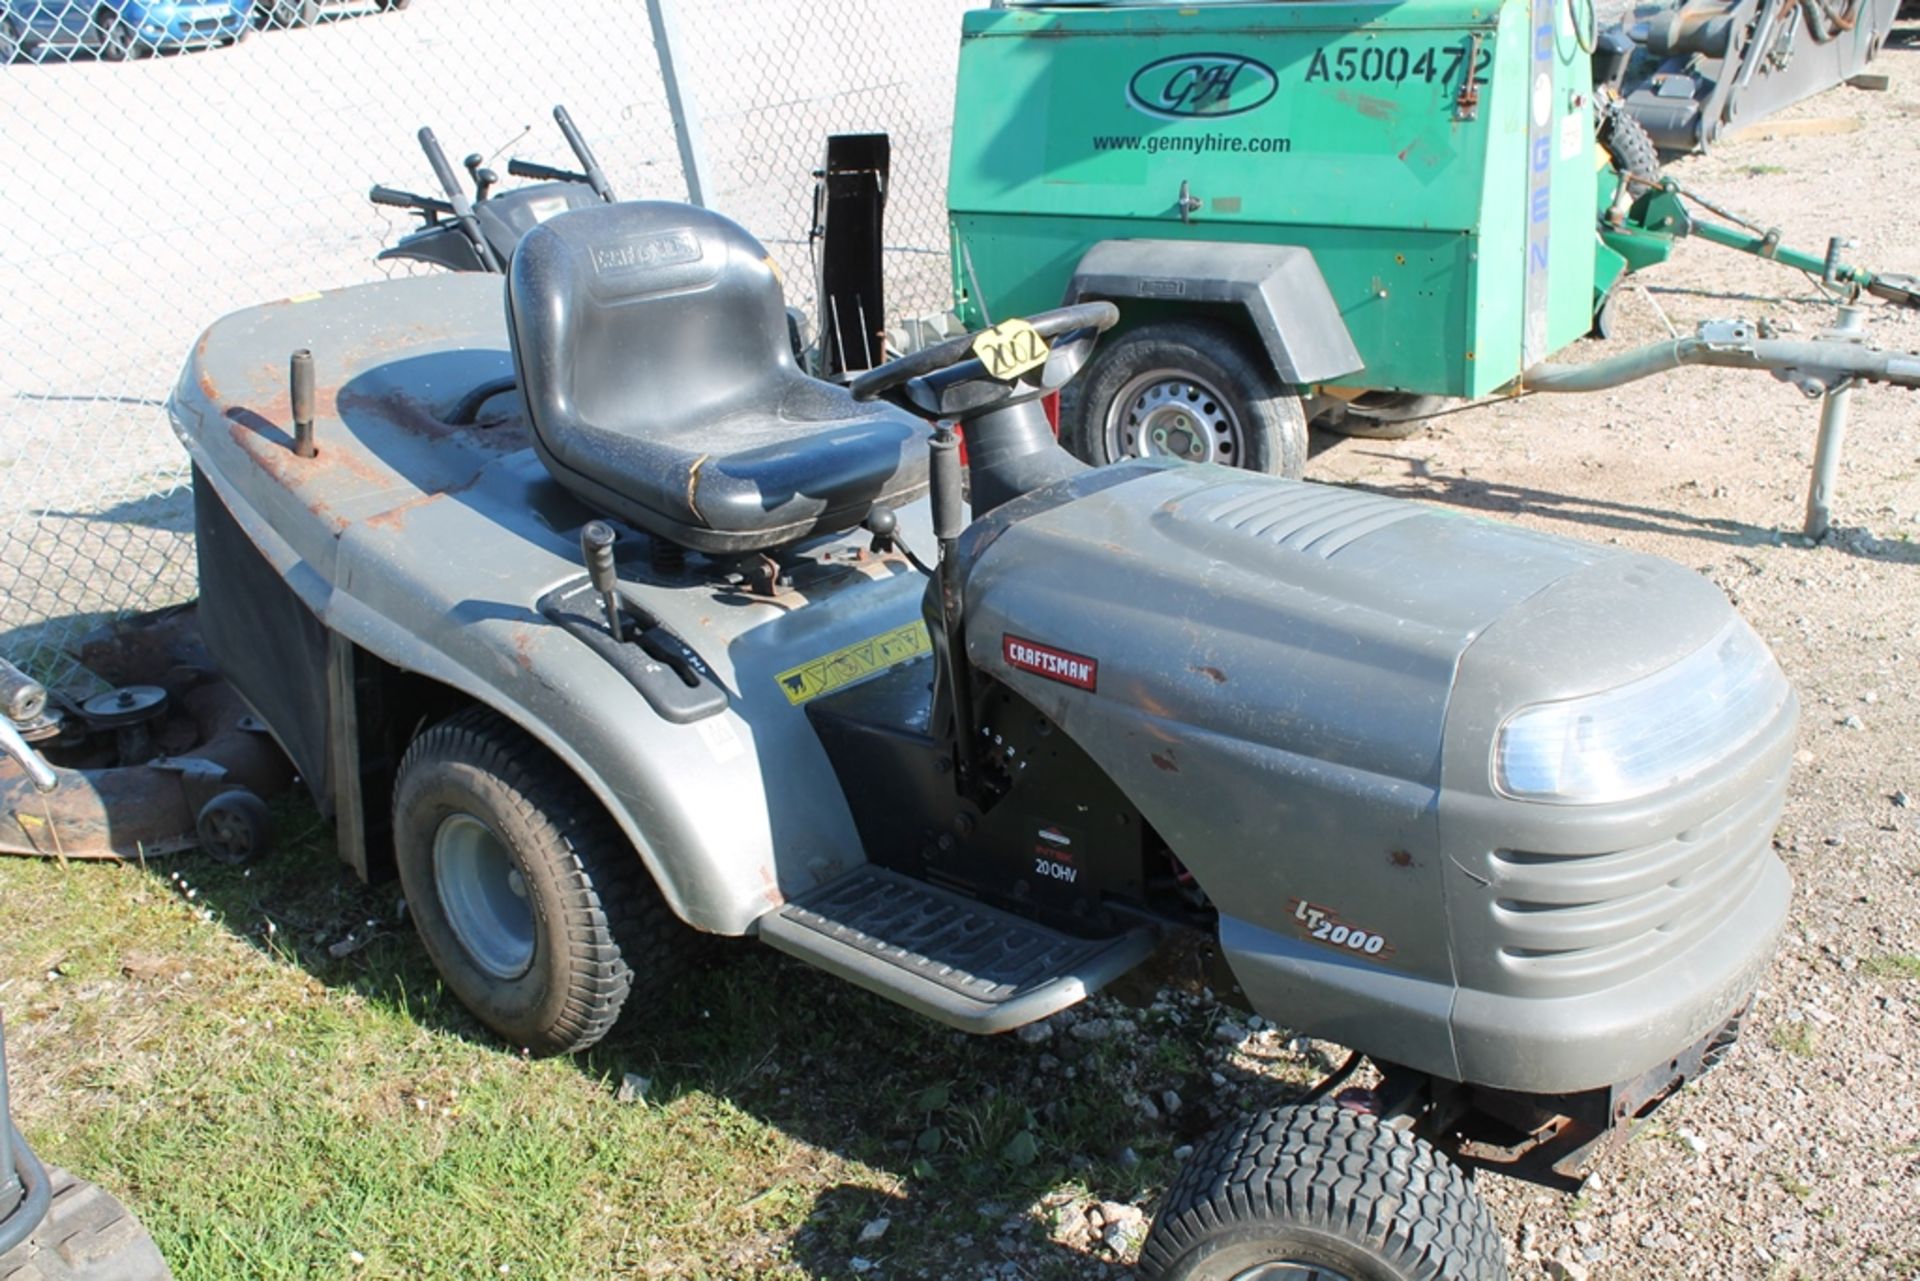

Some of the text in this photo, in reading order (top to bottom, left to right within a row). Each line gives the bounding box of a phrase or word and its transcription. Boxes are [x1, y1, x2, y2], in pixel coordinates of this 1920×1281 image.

[1304, 47, 1490, 84] A500472
[1093, 133, 1291, 155] www.gennyhire.com
[1009, 643, 1090, 682] CRAFTSMAN
